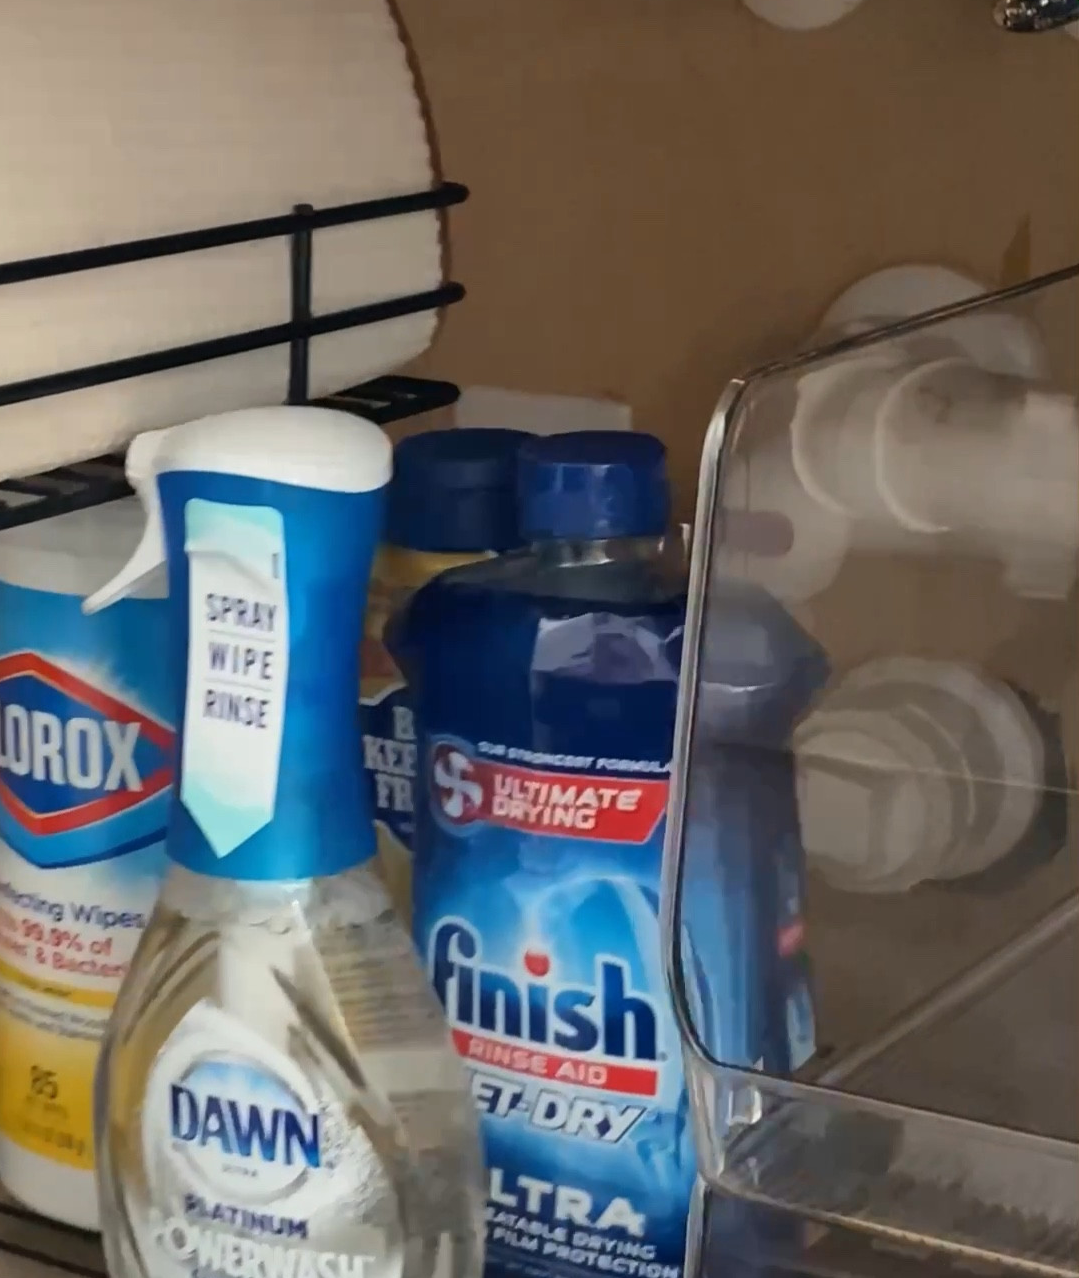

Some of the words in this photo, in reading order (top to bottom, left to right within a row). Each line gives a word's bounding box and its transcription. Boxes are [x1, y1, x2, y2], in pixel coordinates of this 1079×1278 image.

[205, 592, 277, 632] SPRAY
[208, 641, 274, 680] WIPE
[202, 688, 269, 729] RINSE
[491, 795, 599, 830] DRYING
[493, 773, 643, 812] ULTIMATE
[70, 901, 147, 930] Wipes
[432, 922, 658, 1062] finish
[468, 1037, 549, 1075] RINSE
[555, 1060, 609, 1085] AID
[170, 1083, 321, 1169] DAWN
[472, 1071, 648, 1144] ET-DRY
[184, 1192, 309, 1240] PLATINUM
[489, 1166, 647, 1238] LTRA
[484, 1205, 569, 1243] EATABLE
[572, 1231, 657, 1261] DRYING
[492, 1225, 539, 1253] FILM
